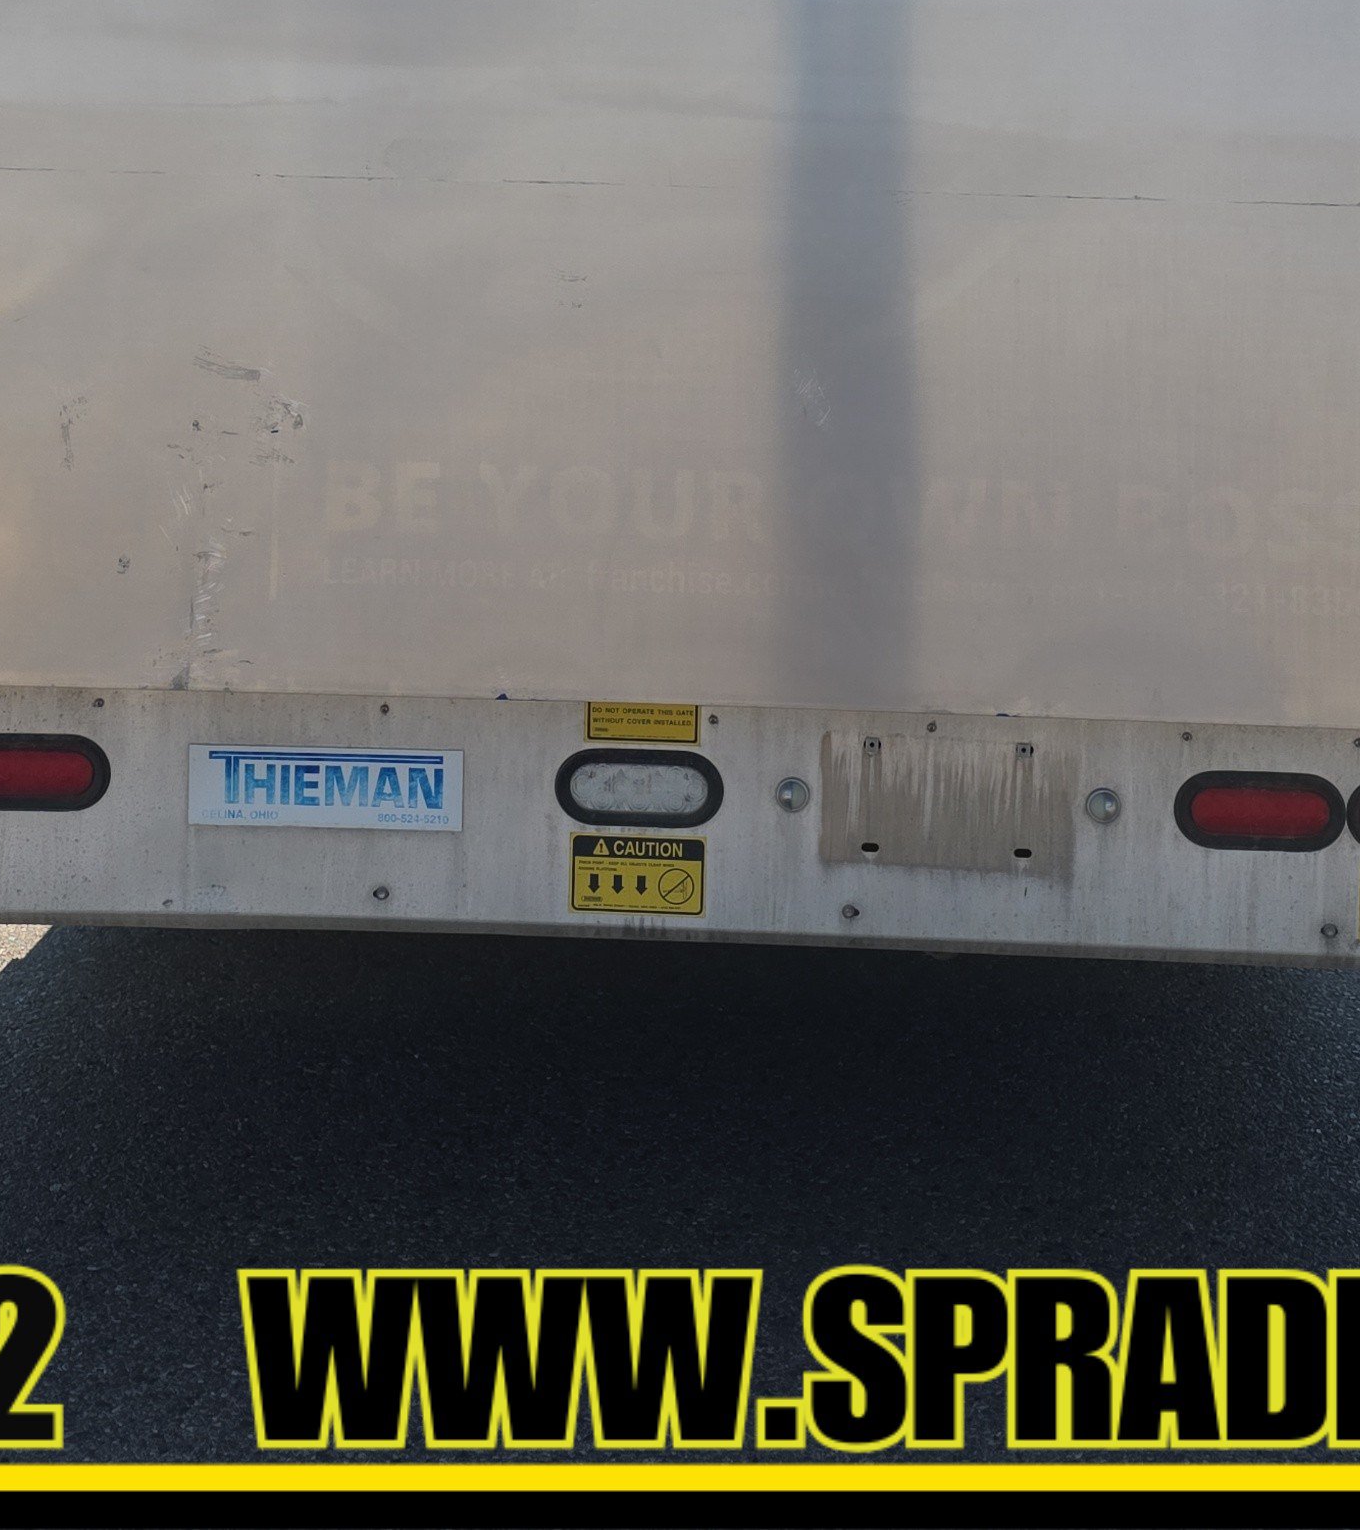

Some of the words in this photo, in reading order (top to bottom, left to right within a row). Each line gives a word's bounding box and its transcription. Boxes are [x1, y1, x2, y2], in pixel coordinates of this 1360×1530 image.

[321, 460, 441, 534] BE
[478, 462, 766, 546] YOUR
[209, 750, 444, 809] THIEMAN
[613, 840, 683, 858] CAUTION
